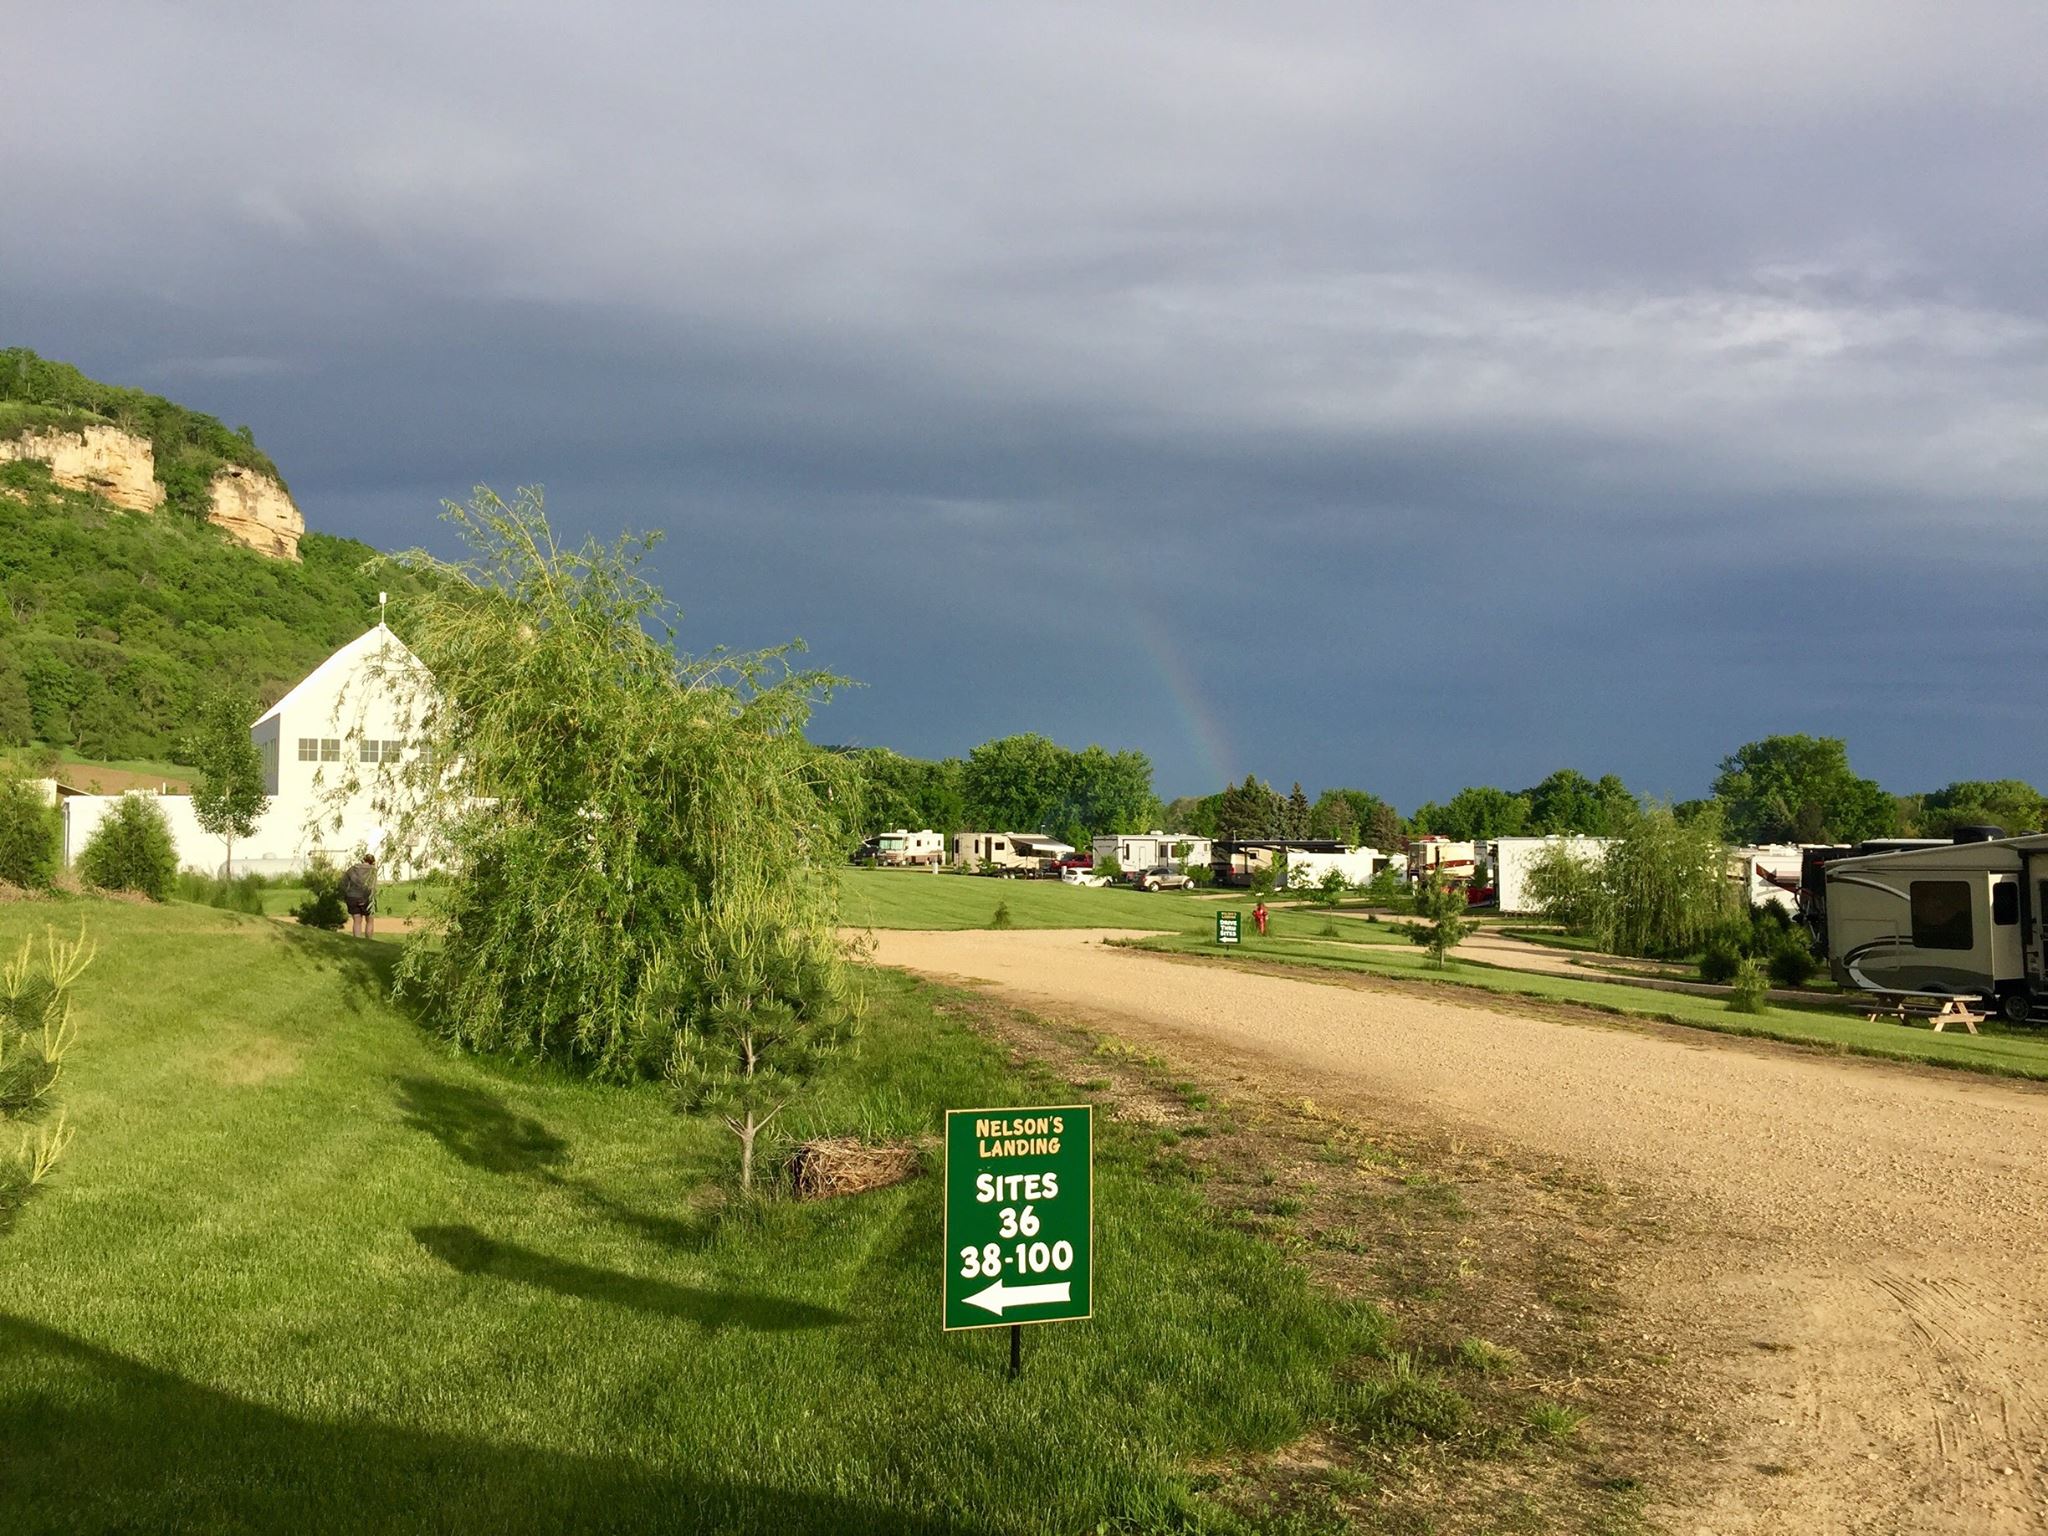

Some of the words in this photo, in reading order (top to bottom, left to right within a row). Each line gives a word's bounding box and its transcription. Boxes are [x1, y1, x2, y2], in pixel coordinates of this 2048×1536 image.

[976, 1115, 1064, 1138] NELSON'S
[979, 1137, 1061, 1158] LANDING
[976, 1172, 1059, 1203] SITES
[998, 1205, 1040, 1238] 36
[960, 1240, 1074, 1278] 38-100
